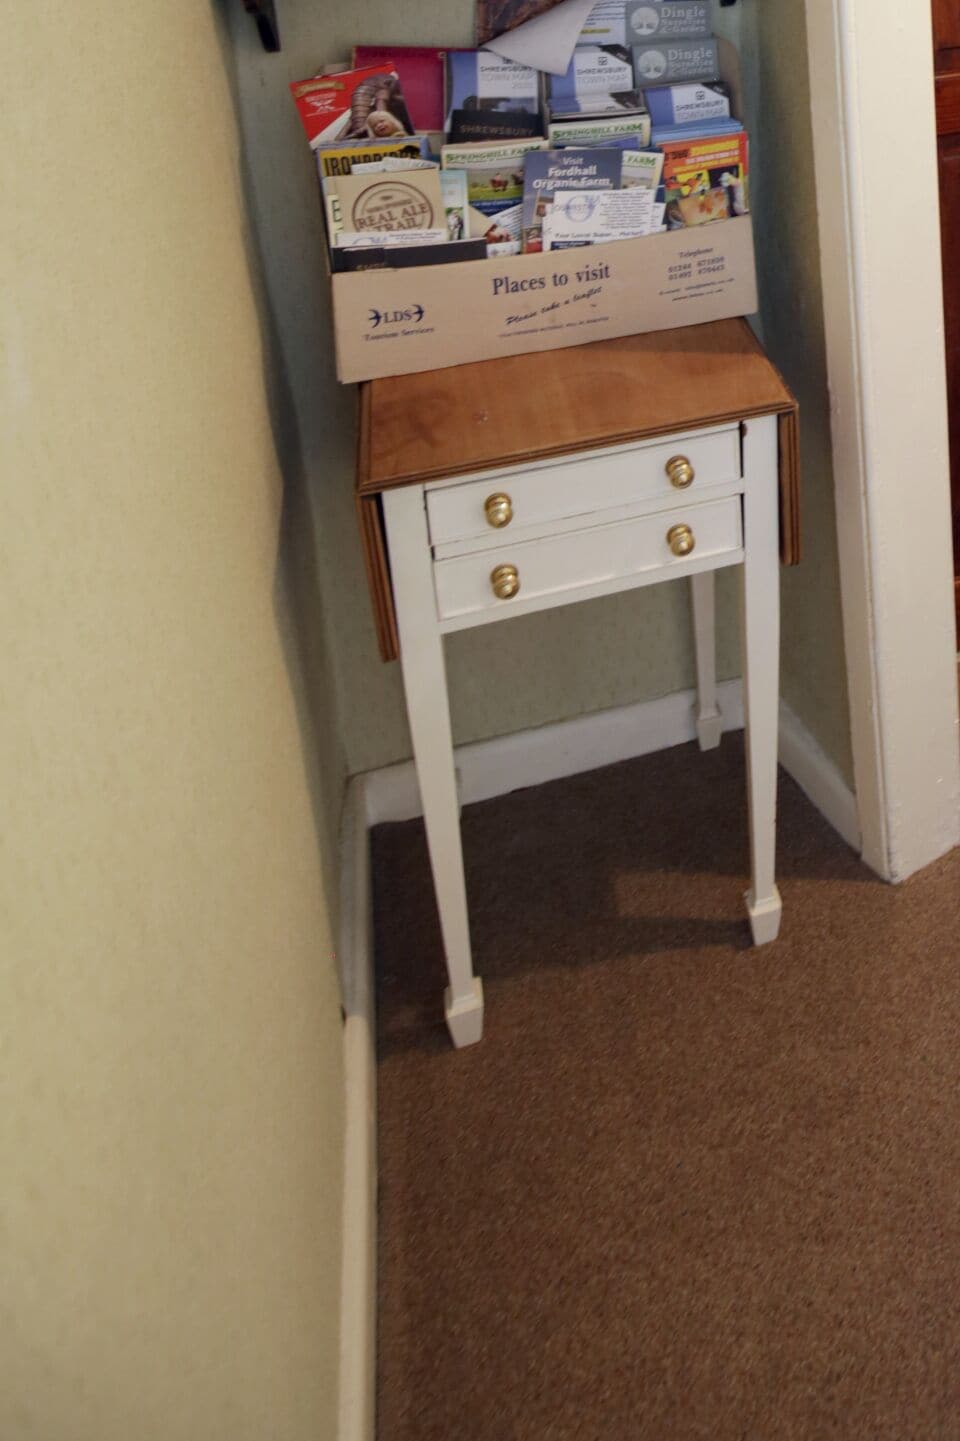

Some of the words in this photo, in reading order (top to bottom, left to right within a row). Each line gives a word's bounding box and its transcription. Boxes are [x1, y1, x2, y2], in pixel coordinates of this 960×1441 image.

[661, 5, 706, 21] Dingle
[668, 47, 713, 62] Dingle
[548, 165, 597, 177] Fordhall
[532, 179, 578, 190] Organic
[356, 210, 397, 229] REAL
[401, 203, 429, 218] ALE
[373, 217, 422, 232] TRAIL
[492, 275, 546, 296] Places
[552, 273, 569, 287] to
[576, 262, 611, 283] visit
[383, 309, 413, 324] LDS
[505, 310, 538, 325] Please
[541, 302, 561, 313] take
[400, 327, 435, 336] Services
